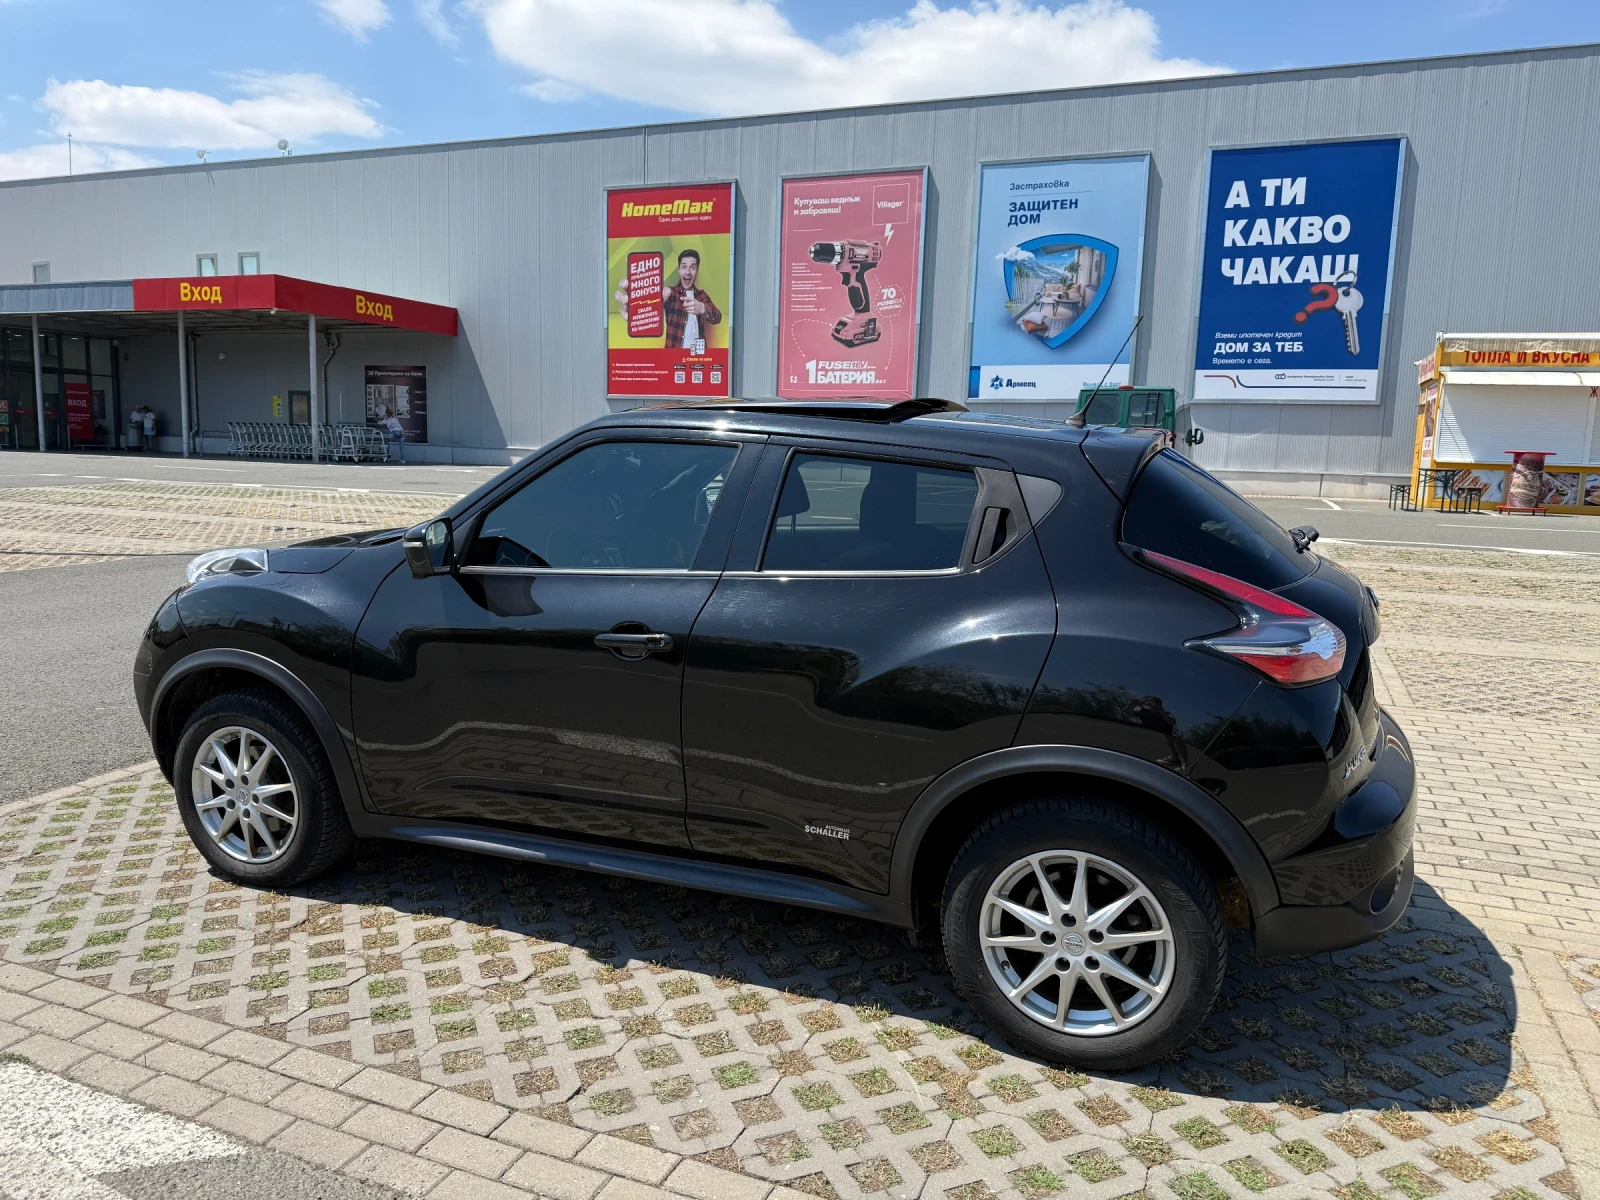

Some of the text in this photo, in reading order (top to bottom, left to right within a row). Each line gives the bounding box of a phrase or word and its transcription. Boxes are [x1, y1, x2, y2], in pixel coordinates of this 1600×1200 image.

[1009, 180, 1070, 192] Застраховка
[1224, 177, 1307, 208] А ТИ
[621, 199, 714, 218] HomeMax
[794, 196, 861, 208] Купуваш веднъж
[877, 200, 904, 209] Villager
[1009, 198, 1078, 213] ЗАЩИТЕН
[800, 206, 842, 217] забравяш!
[1008, 213, 1041, 228] ДОМ
[1223, 214, 1351, 247] КАКВО
[631, 257, 661, 275] ЕДНО
[1221, 254, 1360, 285] ЧАКАШ
[631, 275, 661, 290] МНОГО
[180, 282, 222, 305] Вход
[631, 285, 661, 300] БОНУСИ
[881, 287, 897, 300] 70
[355, 295, 393, 322] Вход
[1215, 331, 1303, 340] Вземи ипотечен кредит
[1213, 342, 1249, 355] ДОМ
[1252, 342, 1272, 353] ЗА
[1212, 358, 1246, 367] Времето
[1254, 358, 1273, 366] сега.
[1516, 351, 1528, 364] И
[1531, 351, 1590, 364] ВКУСНА
[805, 359, 817, 384] 1
[1005, 378, 1037, 390] Армеец
[67, 399, 88, 408] ВХОД
[804, 824, 850, 841] SCHALLER
